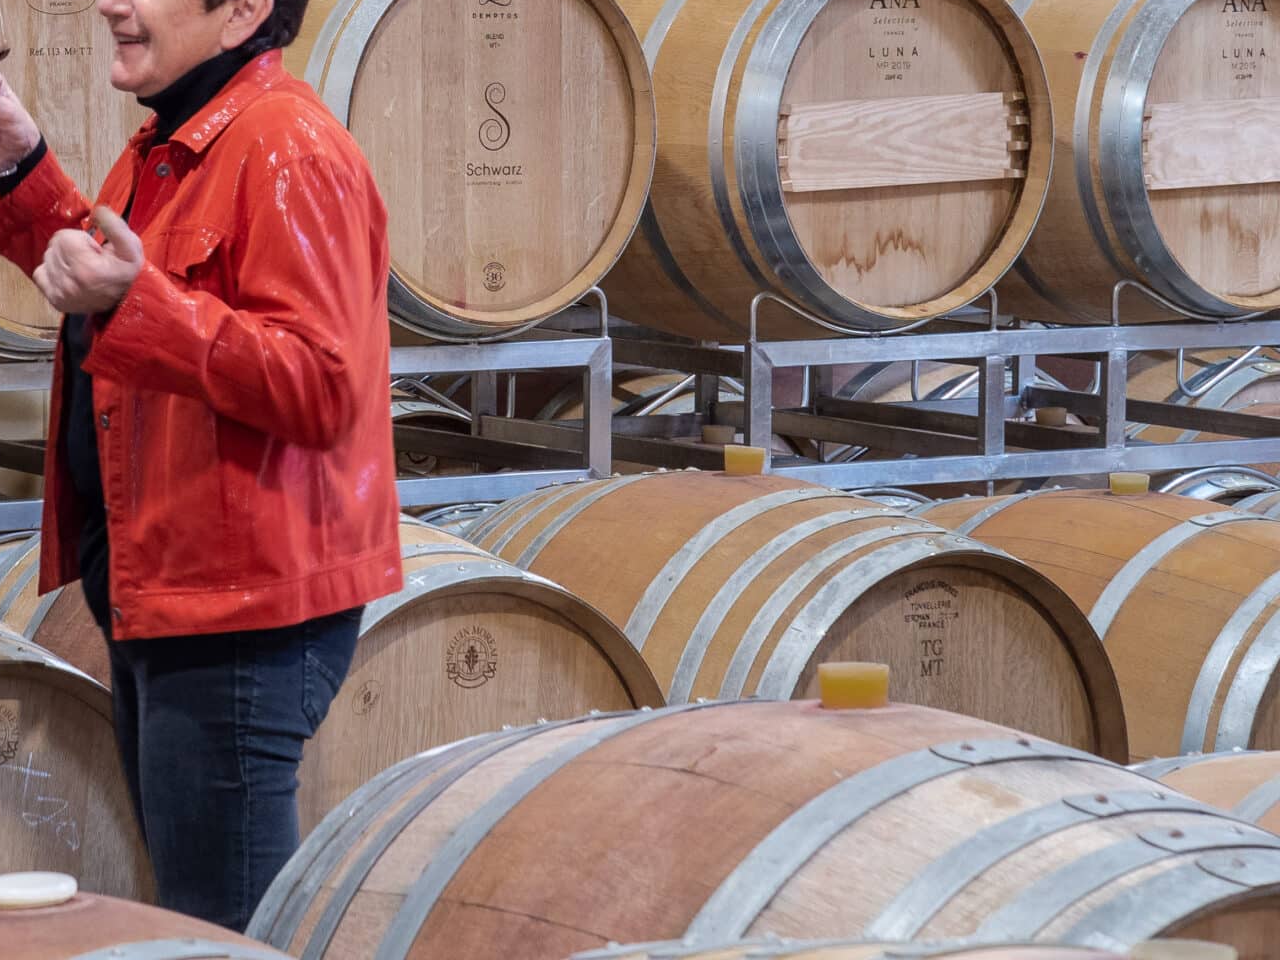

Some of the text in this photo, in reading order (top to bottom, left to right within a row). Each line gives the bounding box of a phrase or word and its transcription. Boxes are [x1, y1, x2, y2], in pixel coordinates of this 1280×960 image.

[873, 16, 916, 25] Selection
[47, 47, 61, 57] 113
[869, 46, 919, 58] LUNA
[1222, 47, 1266, 59] LUNA
[466, 162, 523, 177] Schwarz
[919, 620, 945, 629] FRANCE
[446, 625, 470, 662] SEGUIN
[921, 638, 943, 657] TG
[920, 658, 944, 678] MT
